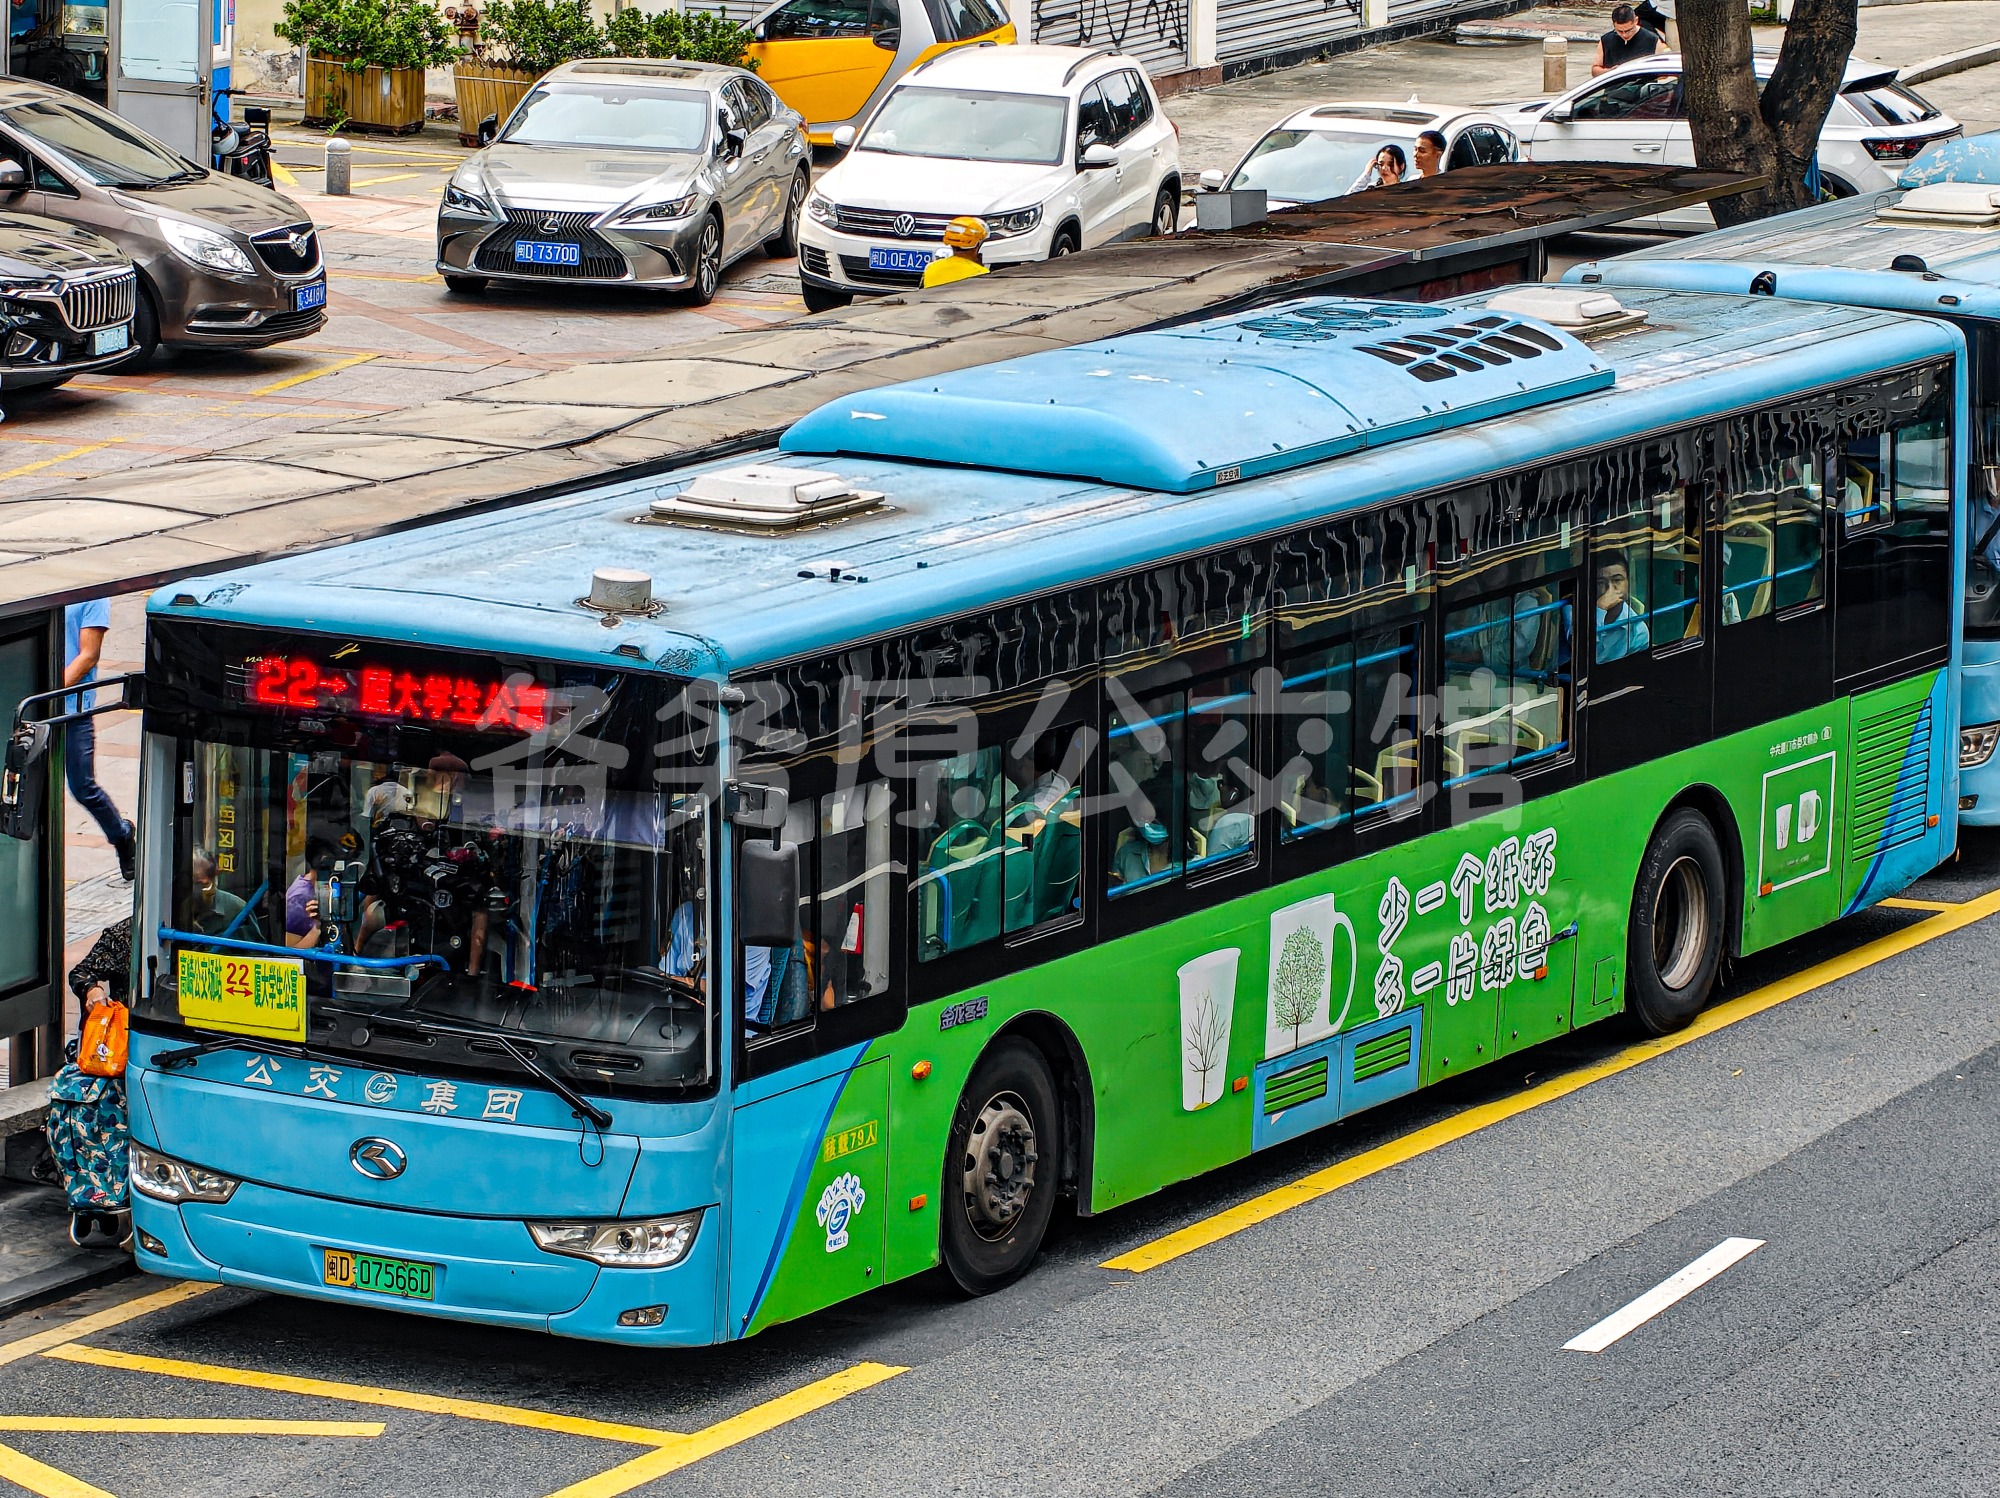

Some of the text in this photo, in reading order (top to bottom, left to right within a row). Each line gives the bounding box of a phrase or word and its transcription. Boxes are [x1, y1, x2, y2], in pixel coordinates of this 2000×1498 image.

[257, 658, 319, 708] 22
[1378, 827, 1557, 955] 少一个纸杯
[226, 962, 249, 987] 22
[1375, 901, 1551, 1018] 多一片绿色
